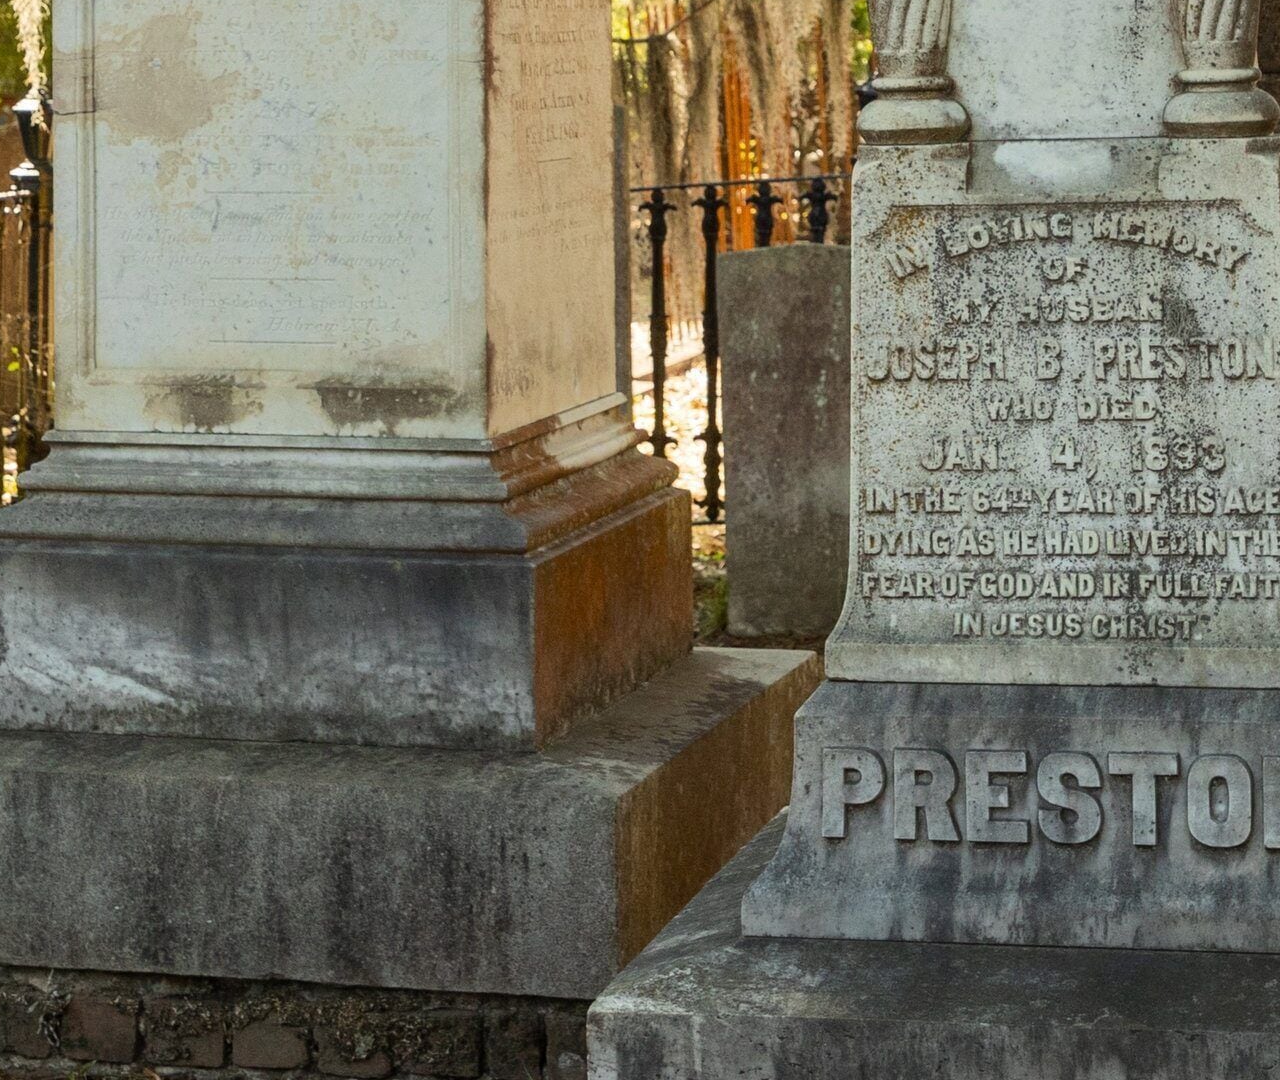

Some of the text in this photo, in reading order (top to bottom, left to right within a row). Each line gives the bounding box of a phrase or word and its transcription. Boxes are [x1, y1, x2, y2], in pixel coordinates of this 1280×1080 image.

[886, 211, 1252, 280] IN LOVING MEMORY
[1041, 256, 1088, 283] OF
[945, 290, 1196, 324] MY HUSBAN
[866, 335, 1008, 382] JOSEPH
[984, 392, 1158, 421] WHO DIED
[1131, 435, 1227, 471] 1893
[865, 487, 896, 514] IN
[899, 487, 962, 514] THE
[1033, 487, 1116, 514] YEAR
[1125, 486, 1163, 515] OF
[1170, 485, 1217, 515] HIS
[862, 529, 952, 556] DYING
[956, 529, 996, 556] AS
[1003, 529, 1040, 557] HE
[1045, 529, 1101, 557] HAD
[1197, 529, 1228, 557] IN
[861, 571, 936, 599] FEAR
[941, 571, 975, 599] OF
[979, 571, 1036, 599] GOD
[1039, 571, 1096, 599] AND
[1102, 572, 1132, 599] IN
[1138, 573, 1208, 600] FULL
[953, 611, 1203, 641] IN JESUS CHRIST.
